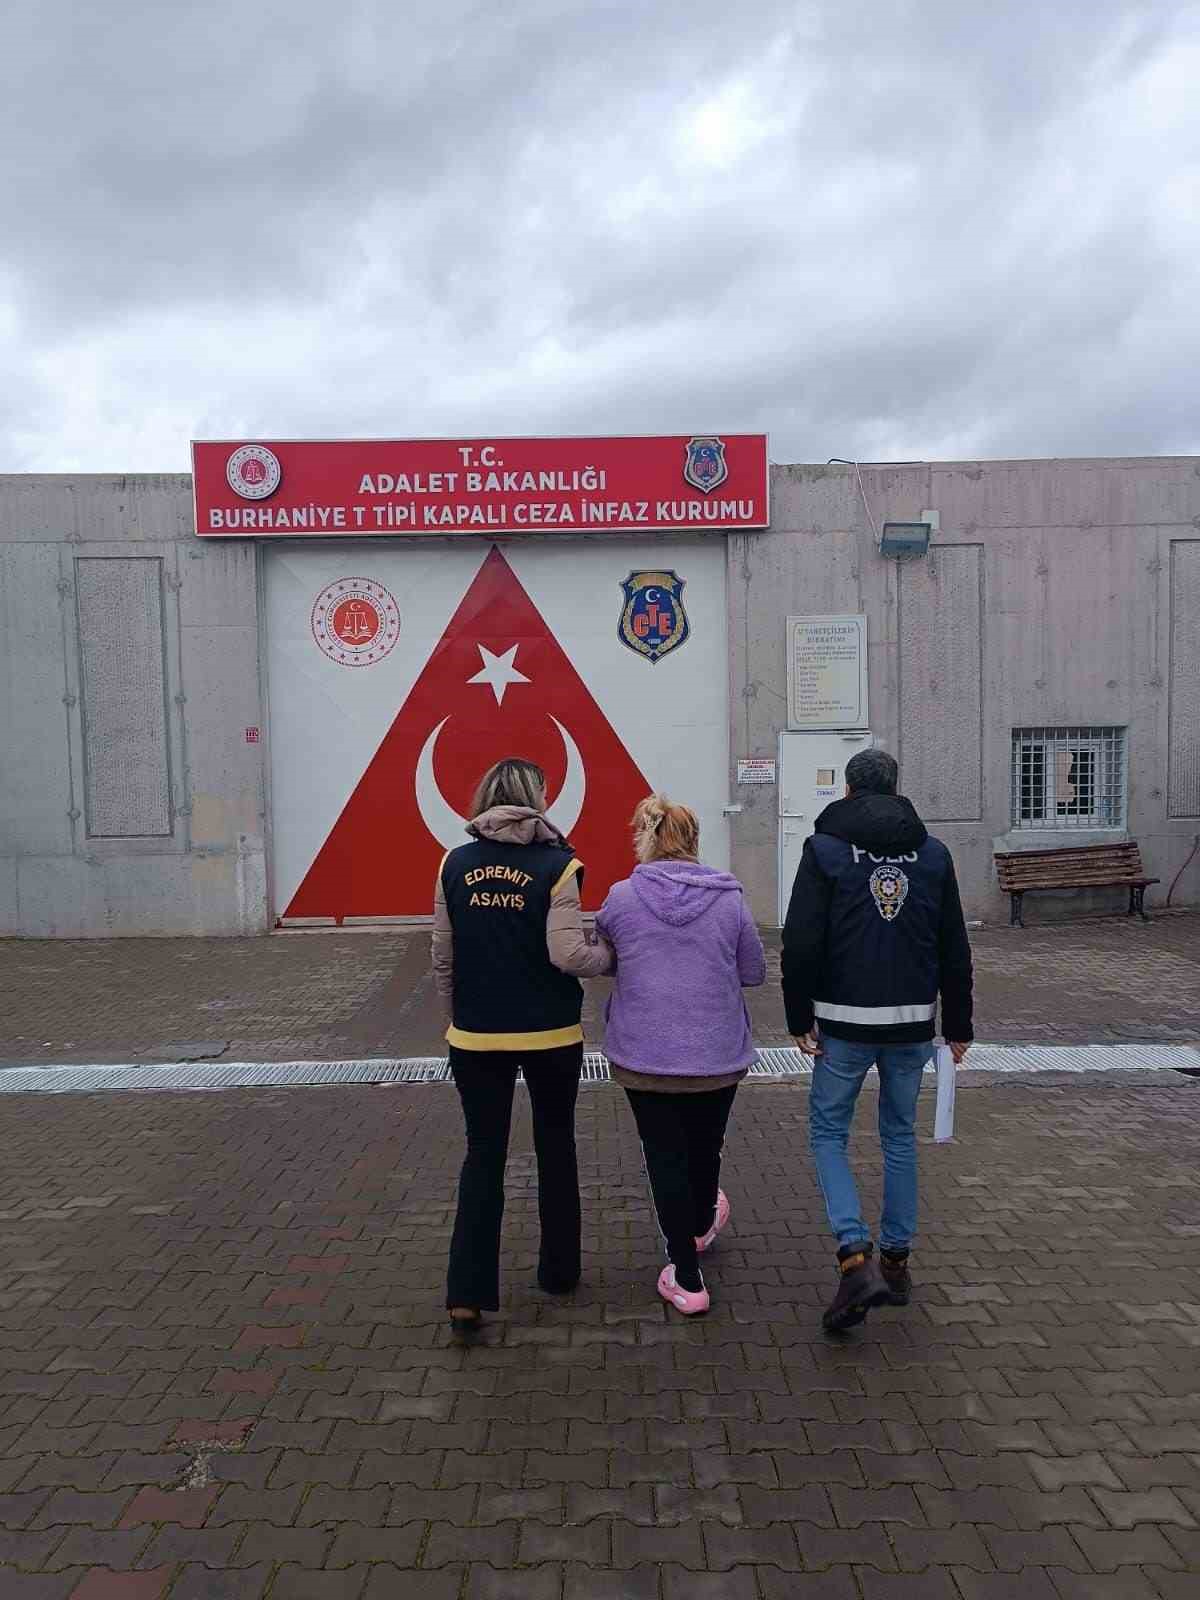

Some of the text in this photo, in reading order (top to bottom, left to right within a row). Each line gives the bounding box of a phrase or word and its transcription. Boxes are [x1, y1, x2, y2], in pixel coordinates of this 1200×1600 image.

[458, 446, 504, 467] T.C.
[358, 466, 607, 494] ADALET BAKANLIĞI
[209, 498, 754, 528] BURHANİYE T TİPİ KAPALI CEZA İNFAZ KURUMU
[464, 865, 534, 887] EDREMİT
[469, 891, 525, 911] ASAYİŞ
